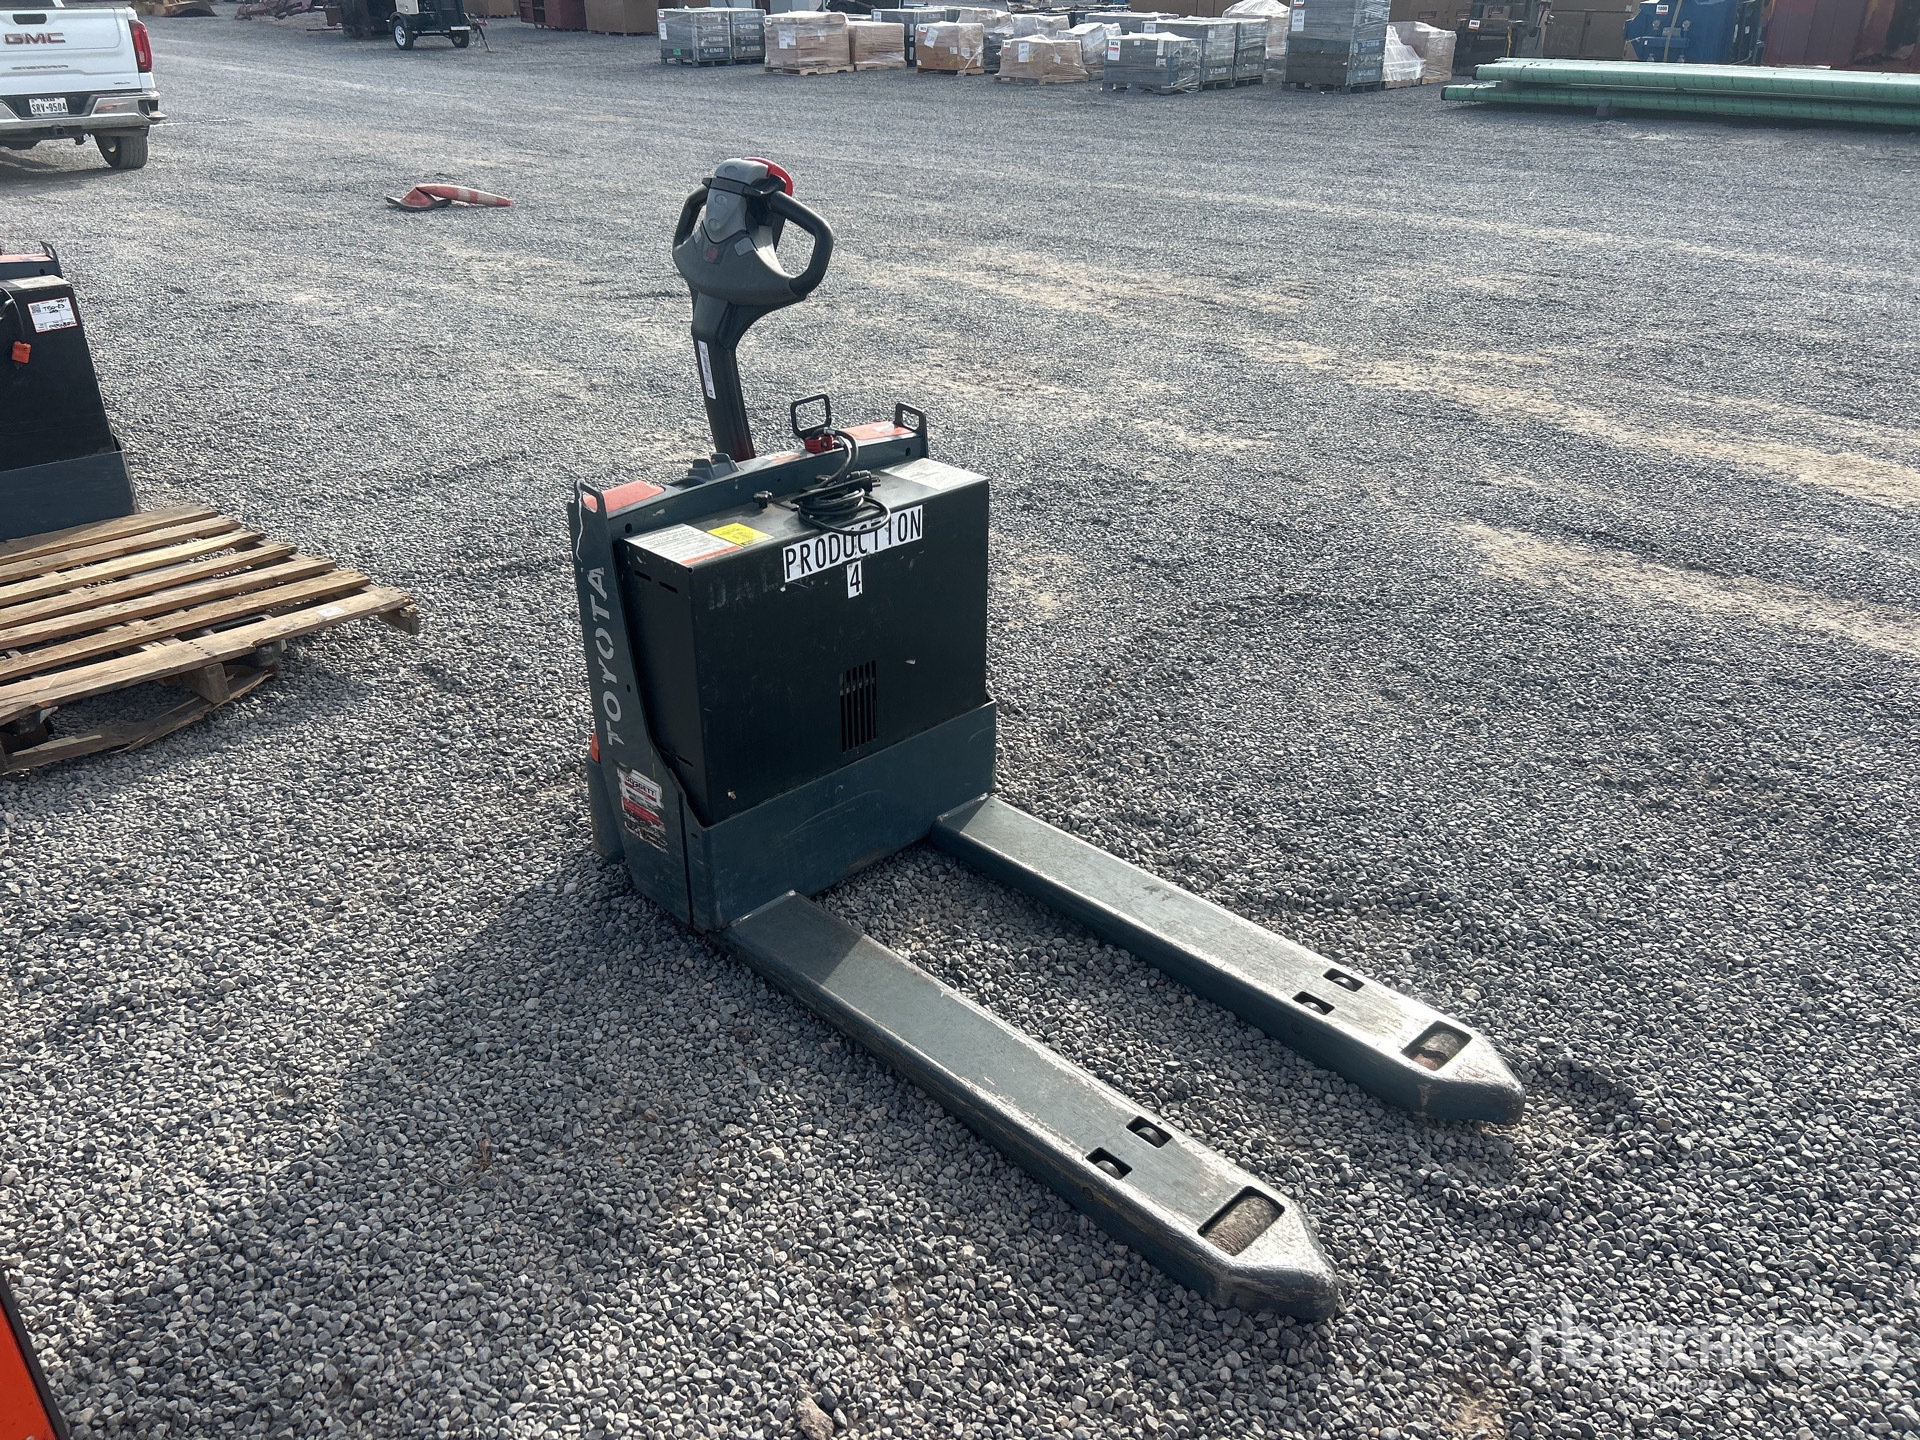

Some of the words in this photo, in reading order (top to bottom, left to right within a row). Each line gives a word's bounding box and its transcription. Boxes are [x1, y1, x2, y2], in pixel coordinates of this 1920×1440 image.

[4, 32, 66, 44] GMC
[785, 508, 922, 580] PRODUCTION
[850, 563, 861, 593] 4
[587, 566, 624, 746] TOYOTA
